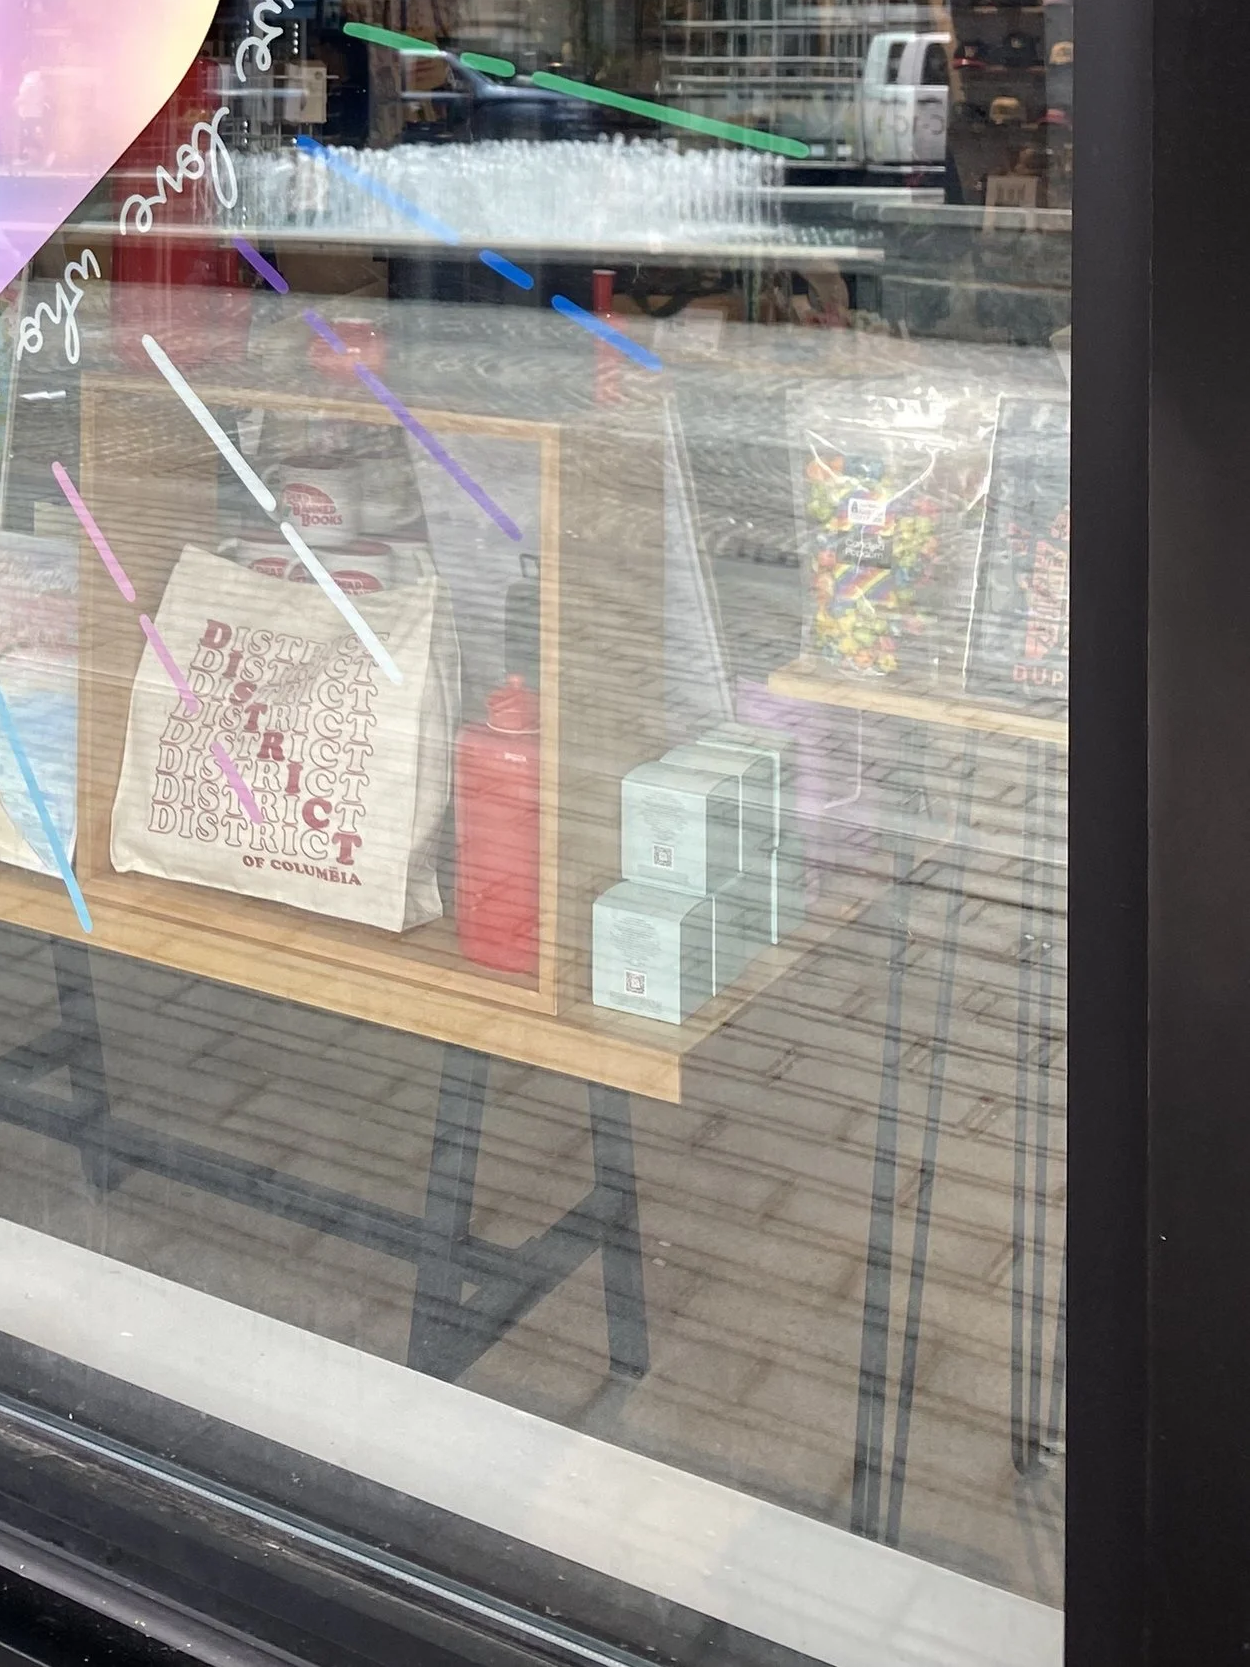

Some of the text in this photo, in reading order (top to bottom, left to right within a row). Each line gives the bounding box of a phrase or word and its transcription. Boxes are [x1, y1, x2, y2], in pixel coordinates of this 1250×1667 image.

[119, 107, 239, 236] love
[16, 248, 102, 365] who
[301, 514, 343, 527] BOOKS
[160, 717, 374, 773] DISTRICT
[170, 695, 378, 743] DISTRICT
[157, 743, 370, 802] DISTRICT
[152, 773, 366, 833] DISTRICT
[148, 802, 363, 865] DISTRICT
[242, 854, 363, 887] OF COLUMBIA
